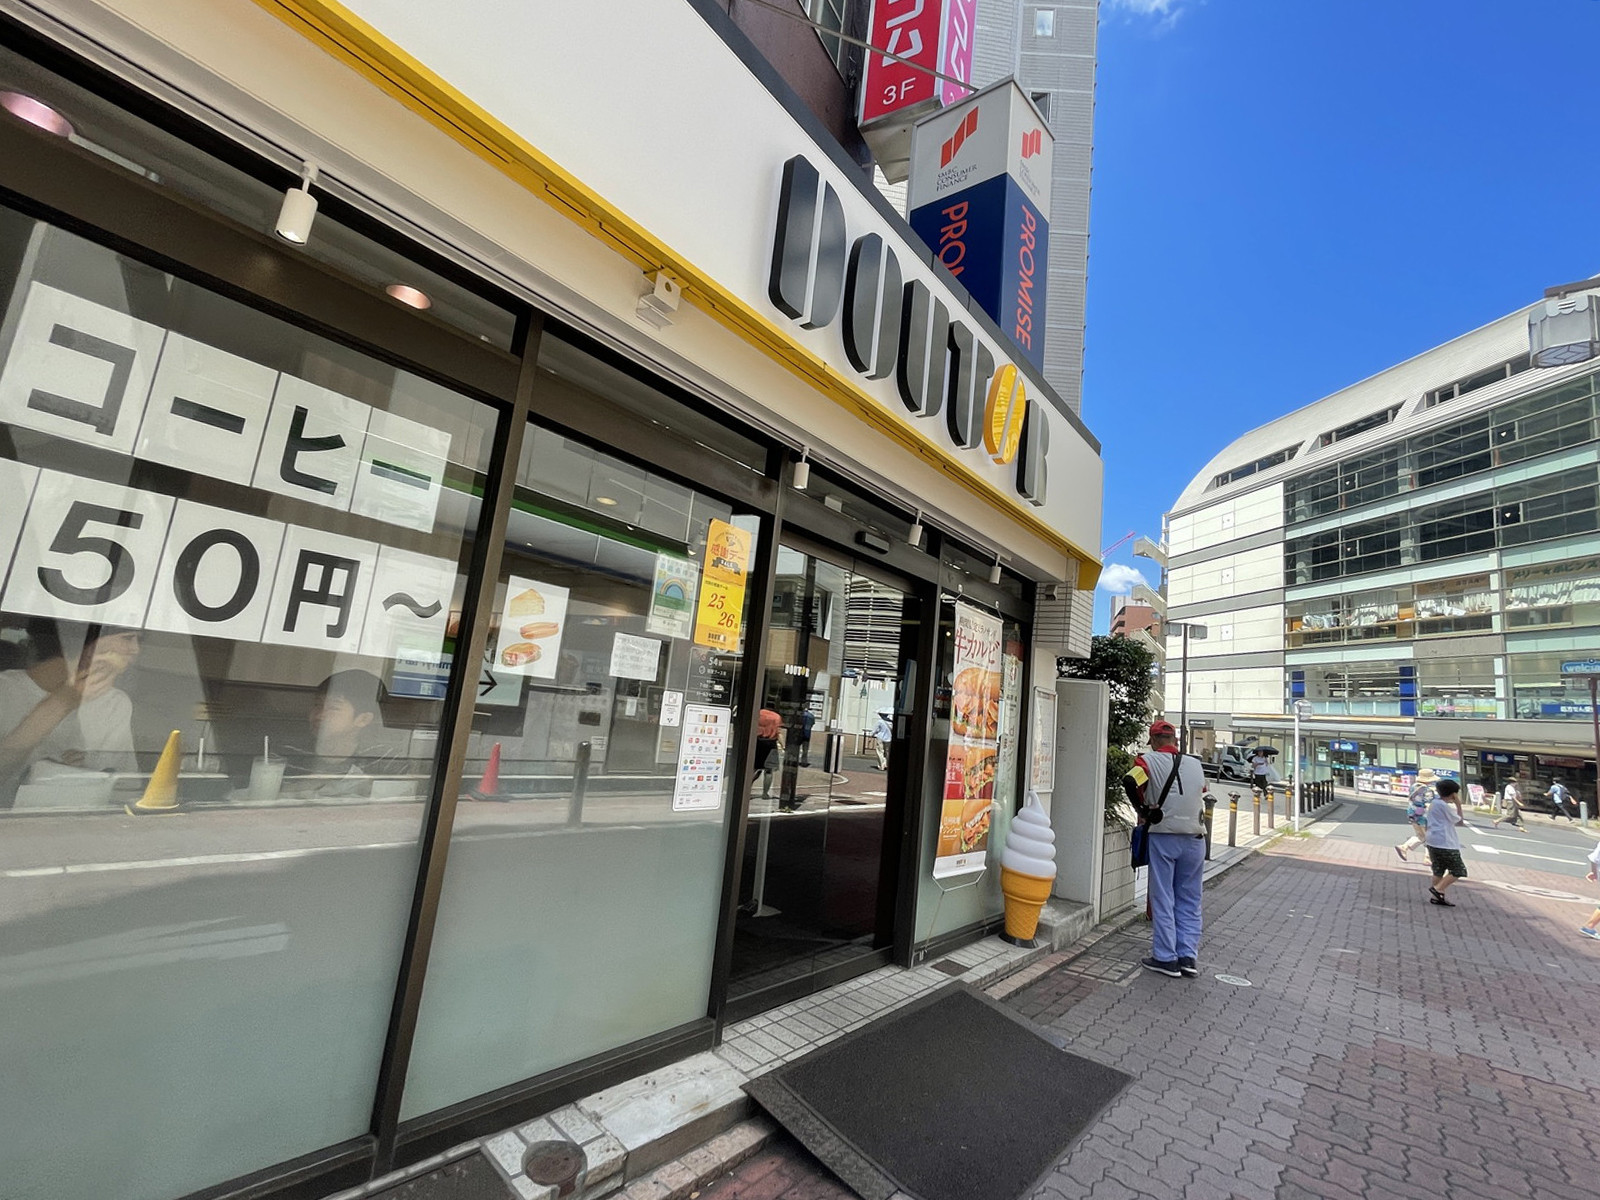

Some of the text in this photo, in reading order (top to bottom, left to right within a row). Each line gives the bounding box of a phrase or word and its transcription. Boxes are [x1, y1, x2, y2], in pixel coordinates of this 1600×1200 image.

[882, 77, 916, 105] 3F
[936, 175, 968, 192] FINANCE
[937, 164, 977, 186] CONSUMER
[939, 201, 968, 276] PRO
[1016, 205, 1037, 350] PROMISE
[768, 154, 1050, 507] DOUTOR
[27, 323, 432, 496] コーヒー
[708, 592, 726, 610] 25
[953, 626, 1000, 664] 牛カルビ
[784, 664, 810, 678] DOUTOR
